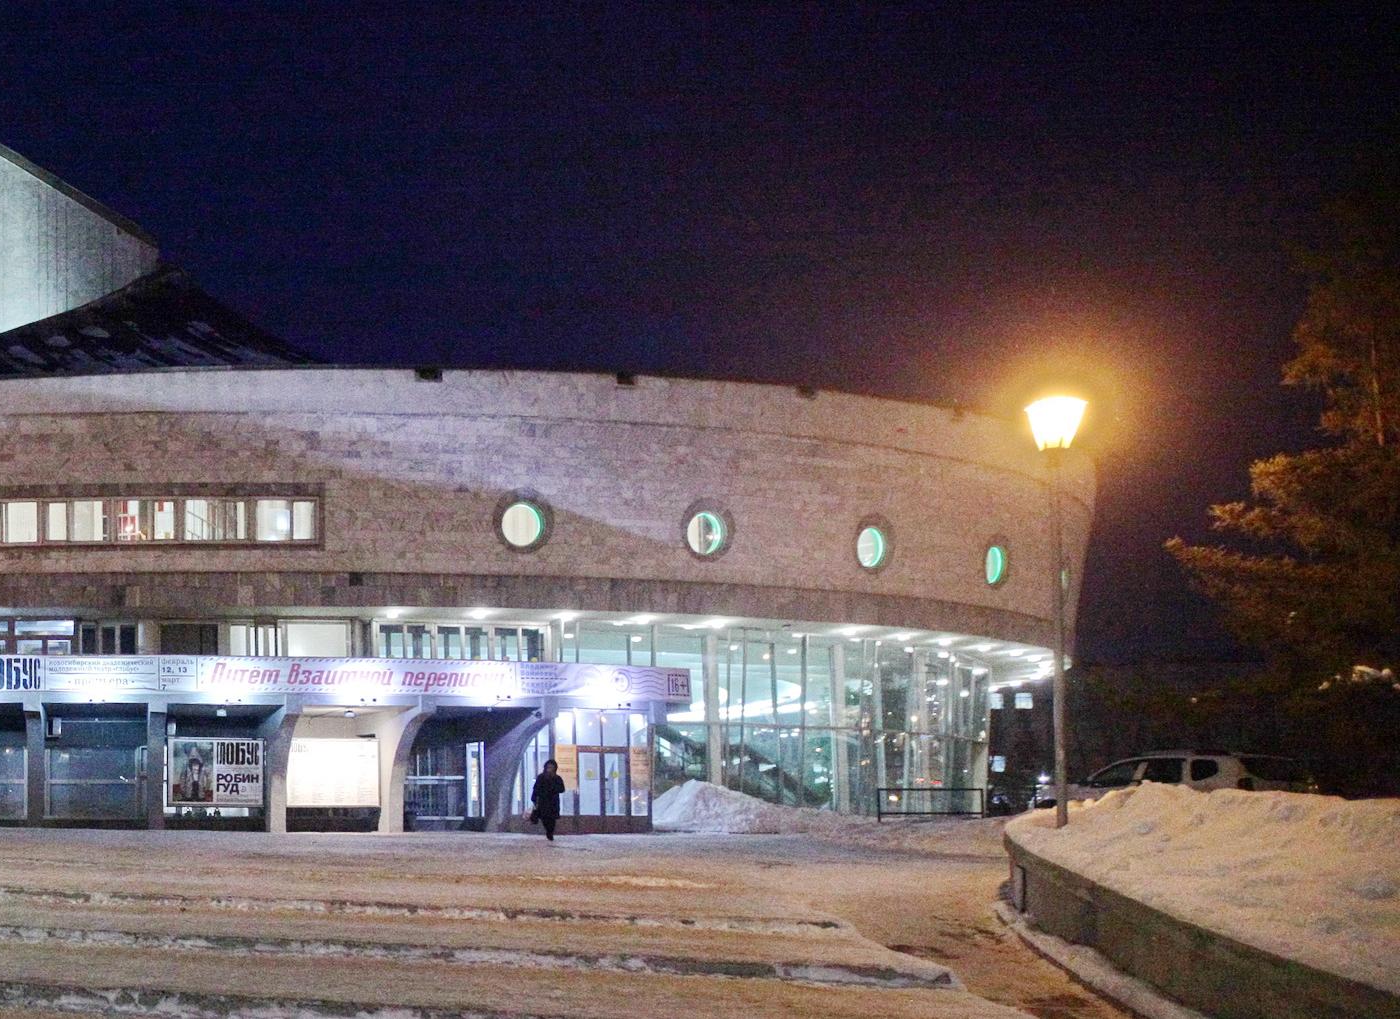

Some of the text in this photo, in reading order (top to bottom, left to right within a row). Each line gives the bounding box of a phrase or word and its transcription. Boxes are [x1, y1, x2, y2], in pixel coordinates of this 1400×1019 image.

[178, 666, 187, 674] 13
[671, 678, 687, 693] 16+
[216, 741, 260, 766] ГЛОБУС
[216, 773, 260, 784] РОБИН
[216, 783, 240, 796] ГУД
